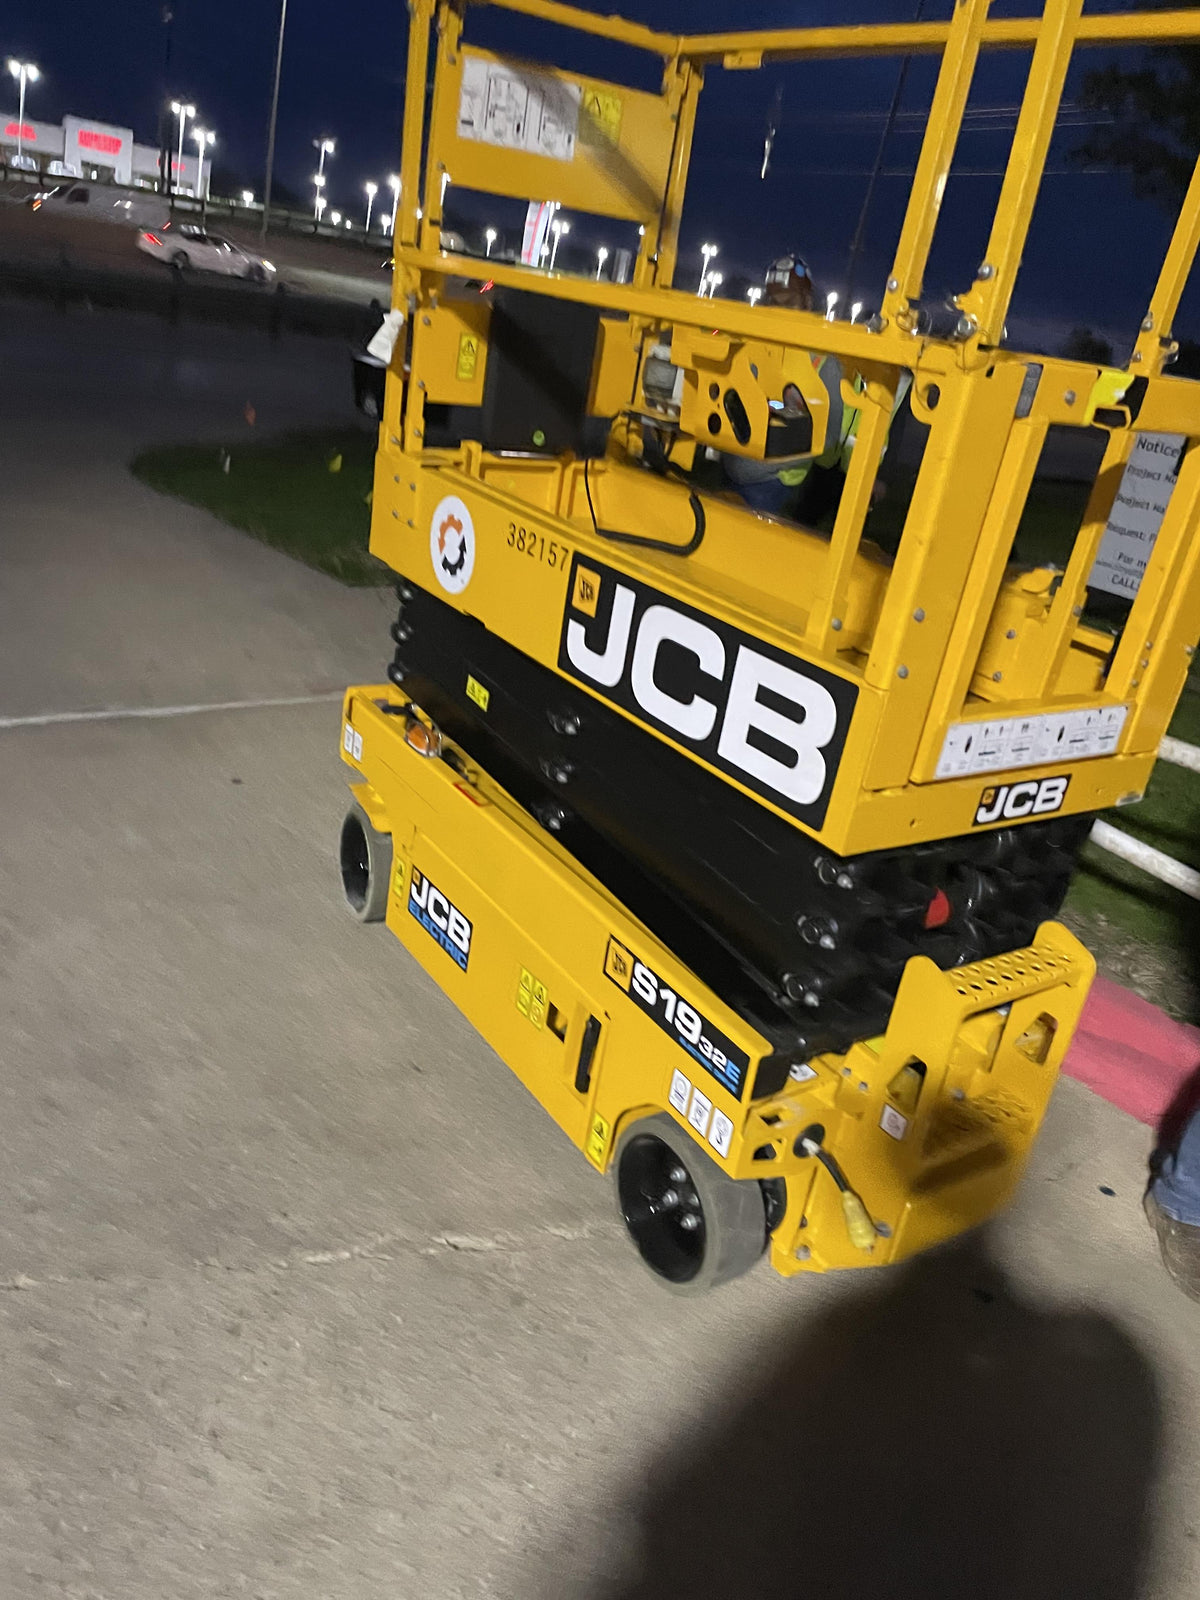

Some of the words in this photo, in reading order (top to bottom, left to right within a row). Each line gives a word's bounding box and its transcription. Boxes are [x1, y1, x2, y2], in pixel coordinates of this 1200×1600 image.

[1137, 436, 1180, 458] Notice
[507, 522, 569, 572] 382157
[566, 583, 837, 805] JCB
[975, 777, 1068, 824] JCB
[408, 898, 468, 970] ELECTRIC
[410, 876, 471, 954] JCB
